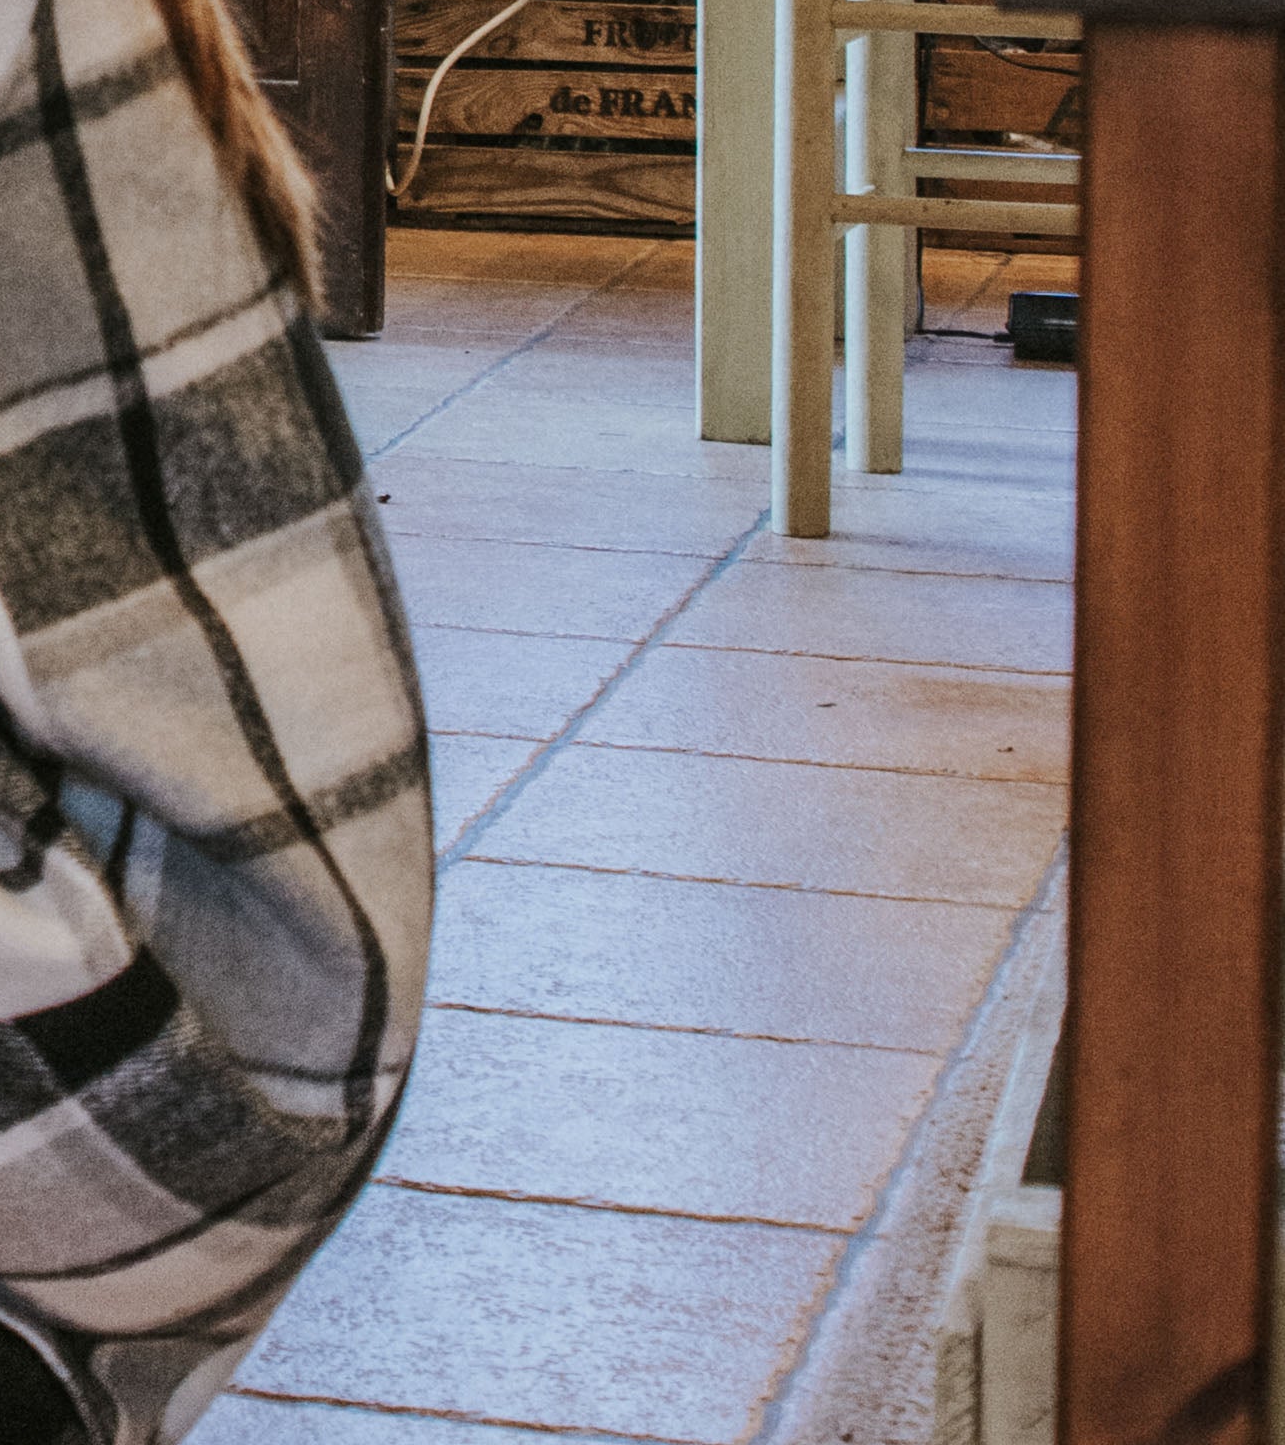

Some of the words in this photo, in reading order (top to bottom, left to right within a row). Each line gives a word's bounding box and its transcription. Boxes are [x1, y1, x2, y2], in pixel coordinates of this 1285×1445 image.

[582, 18, 697, 51] FRUIT
[549, 85, 591, 115] de
[598, 87, 697, 119] FRAN
